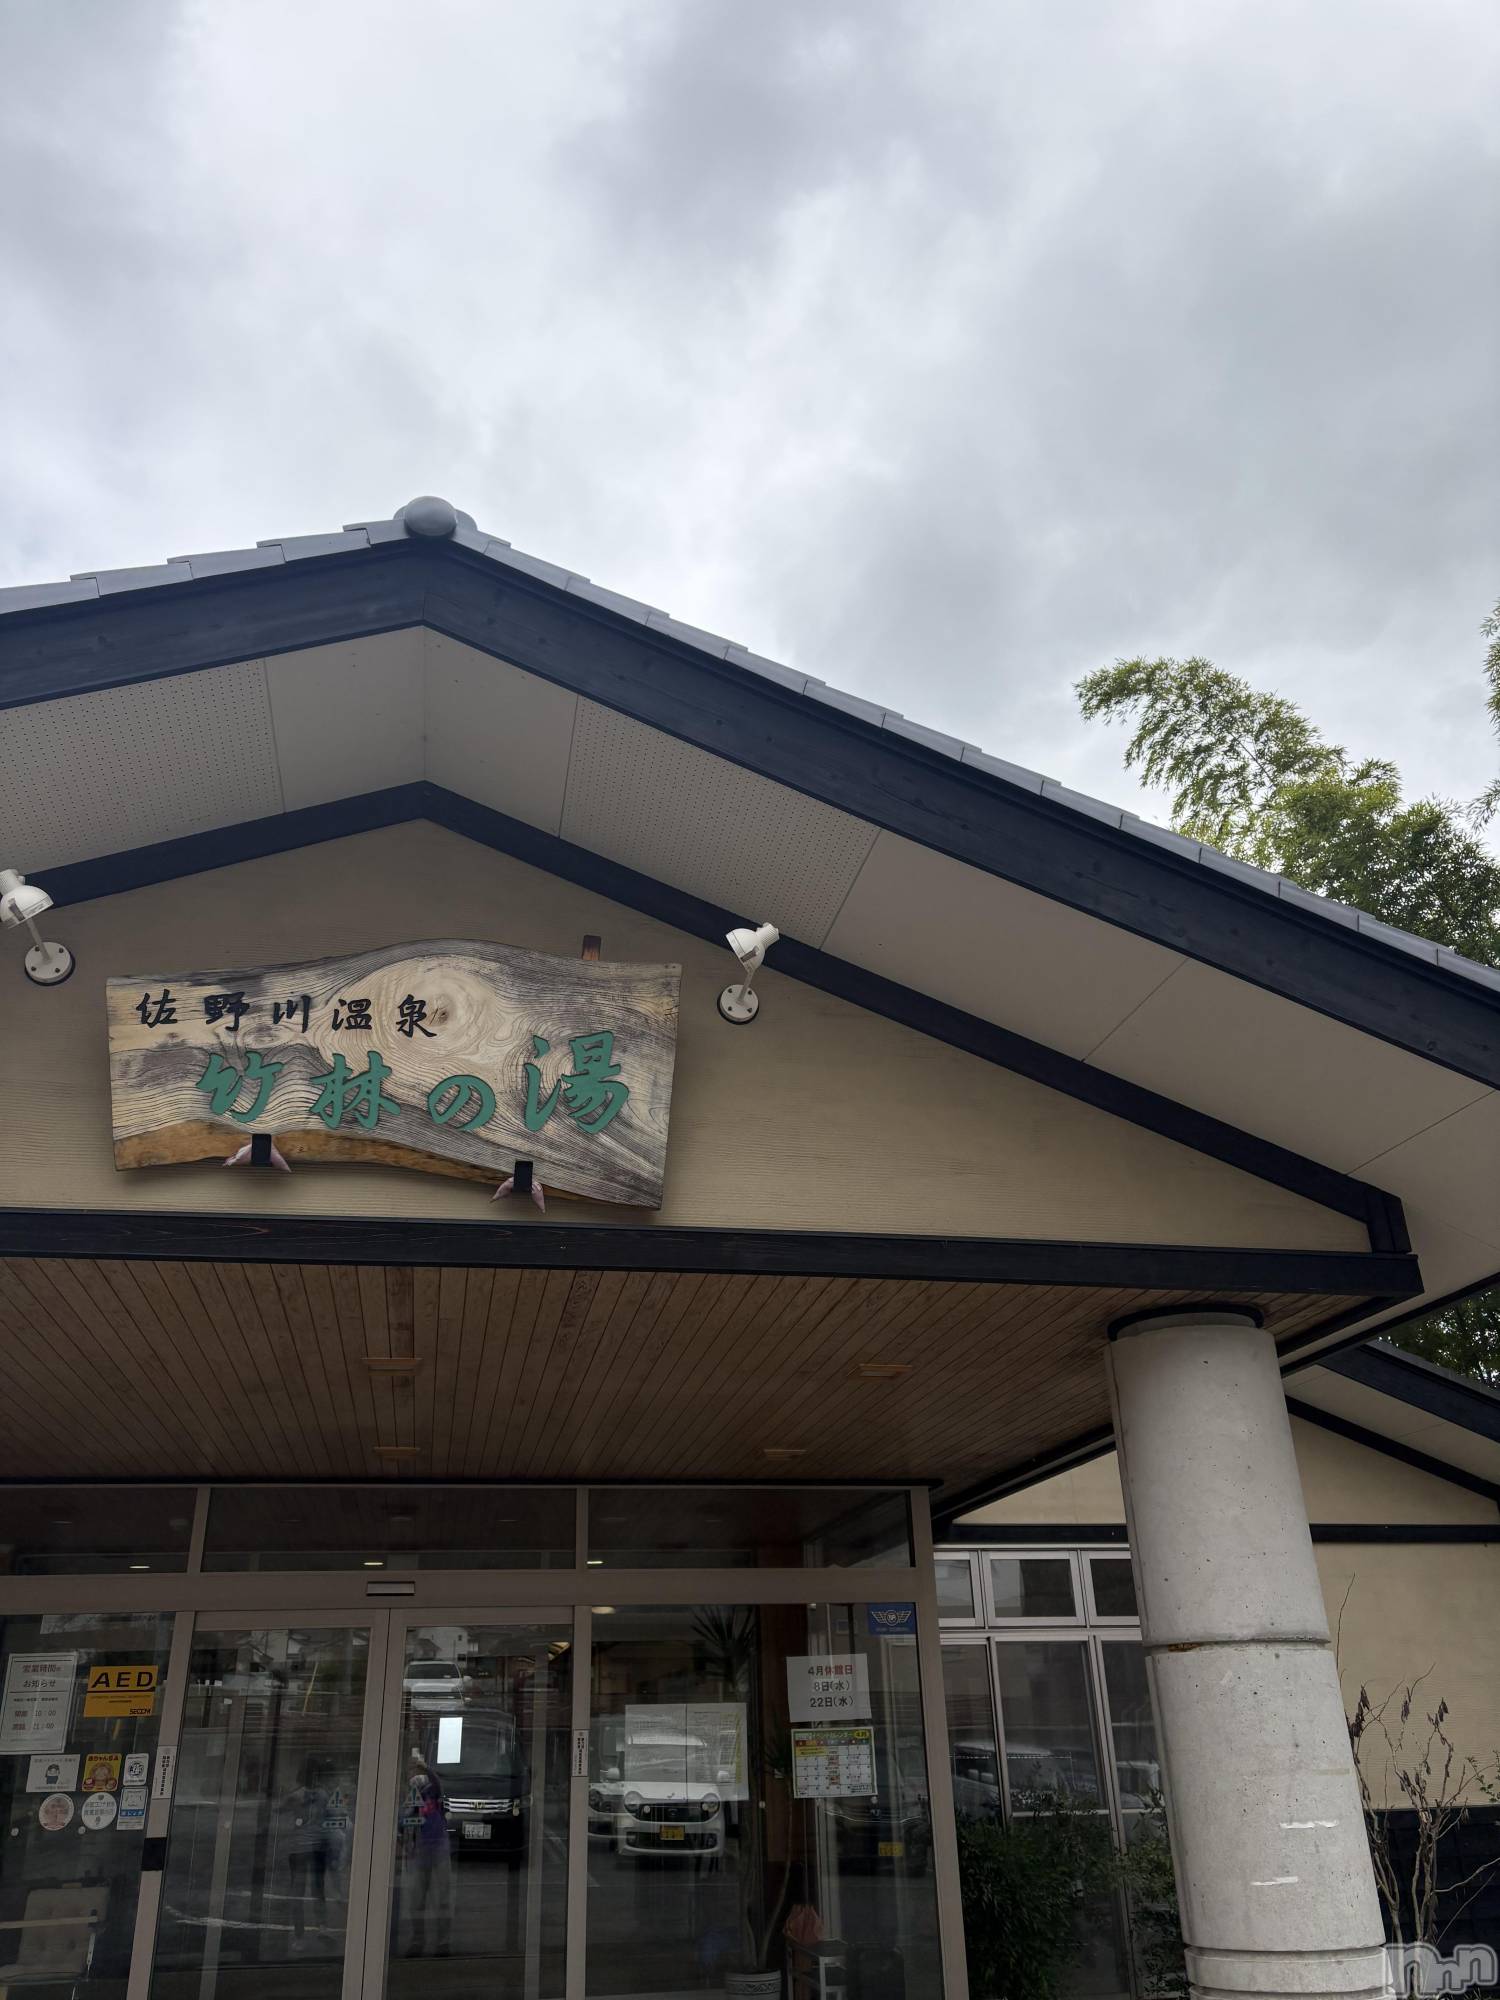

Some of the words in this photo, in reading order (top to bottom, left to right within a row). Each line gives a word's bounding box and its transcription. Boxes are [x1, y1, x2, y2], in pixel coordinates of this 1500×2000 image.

[136, 989, 437, 1038] 佐野川温泉
[196, 1031, 631, 1133] 竹林の湯
[91, 1671, 154, 1688] AED
[810, 1696, 854, 1708] 22日(水)
